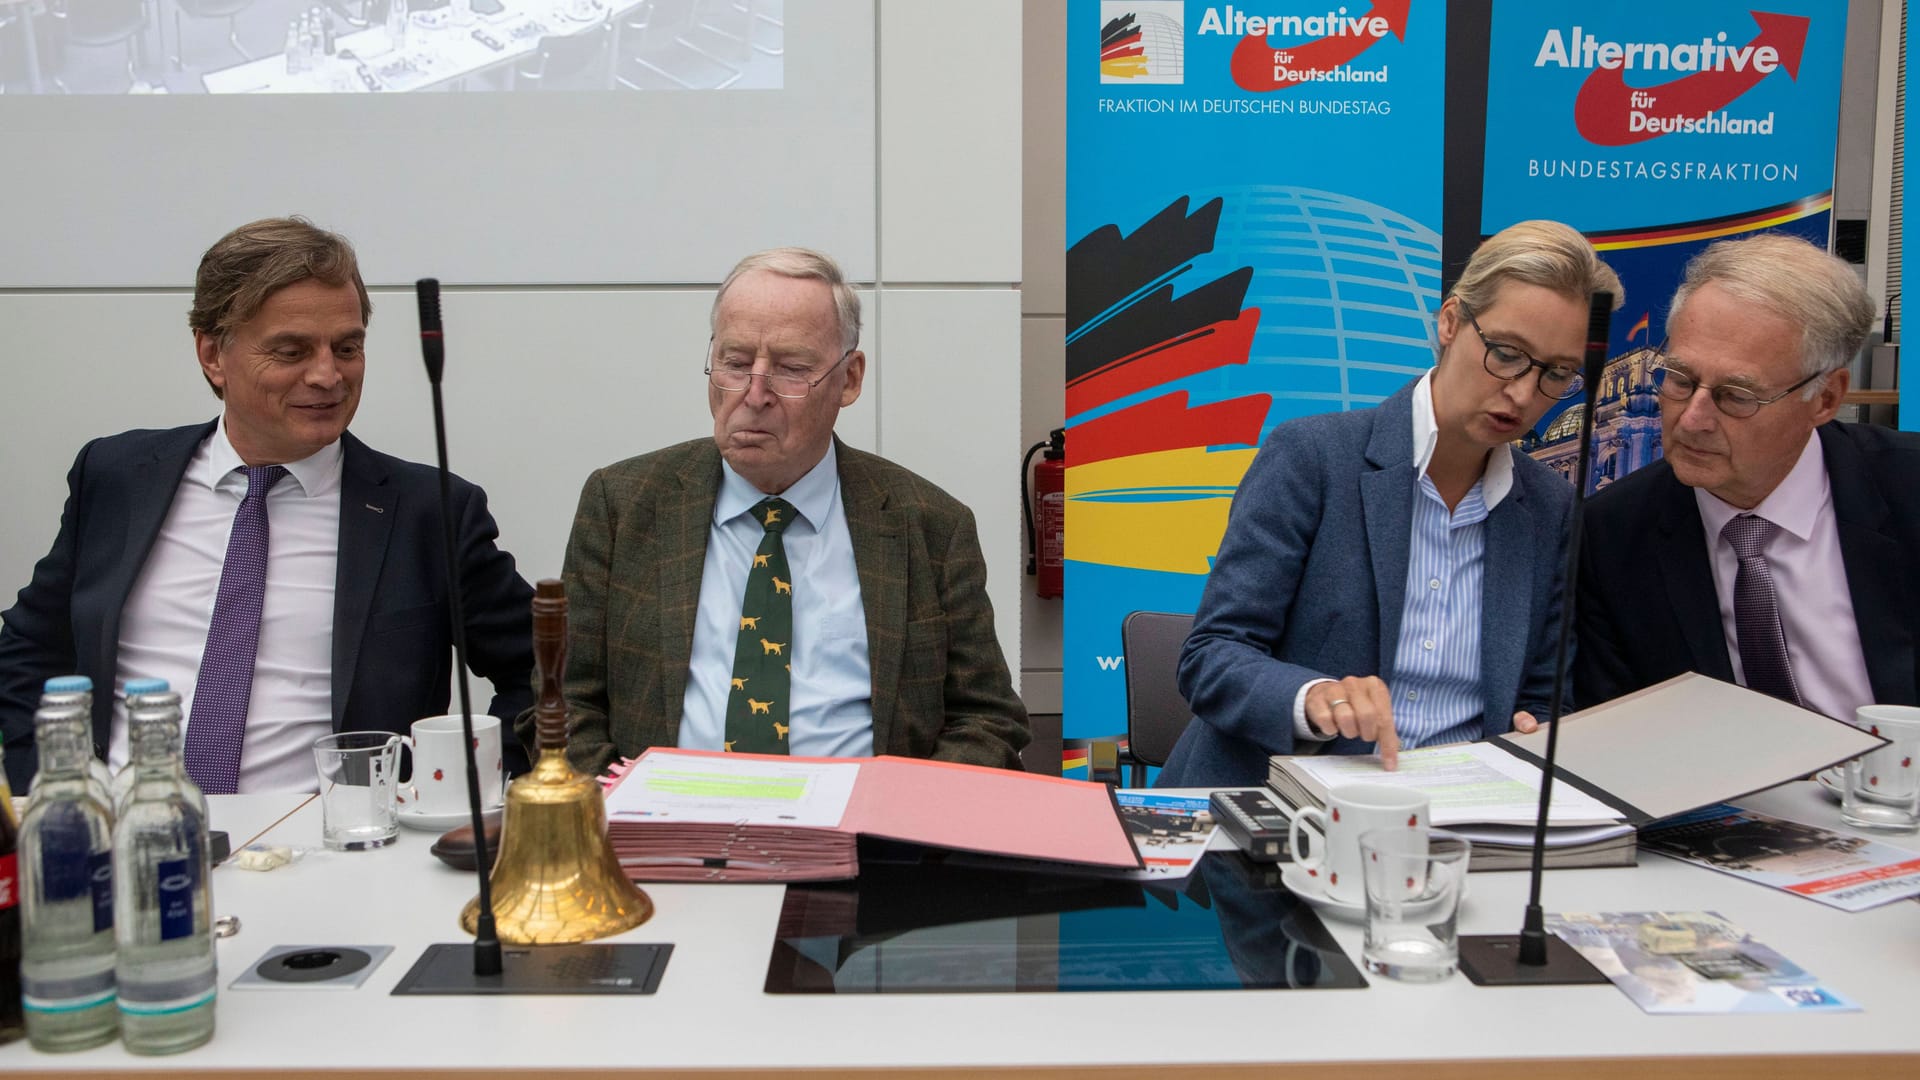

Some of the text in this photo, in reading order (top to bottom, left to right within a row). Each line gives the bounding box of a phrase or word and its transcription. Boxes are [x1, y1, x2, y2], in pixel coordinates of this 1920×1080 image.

[1197, 5, 1389, 38] Alternative
[1273, 50, 1295, 65] für
[1534, 26, 1779, 74] Alternative
[1273, 64, 1388, 83] Deutschland
[1099, 99, 1391, 115] FRAKTION IM DEUTSCHEN BUNDESTAG
[1630, 90, 1657, 109] für
[1629, 110, 1775, 135] Deutschland
[1528, 159, 1799, 182] BUNDESTAGSFRAKTION
